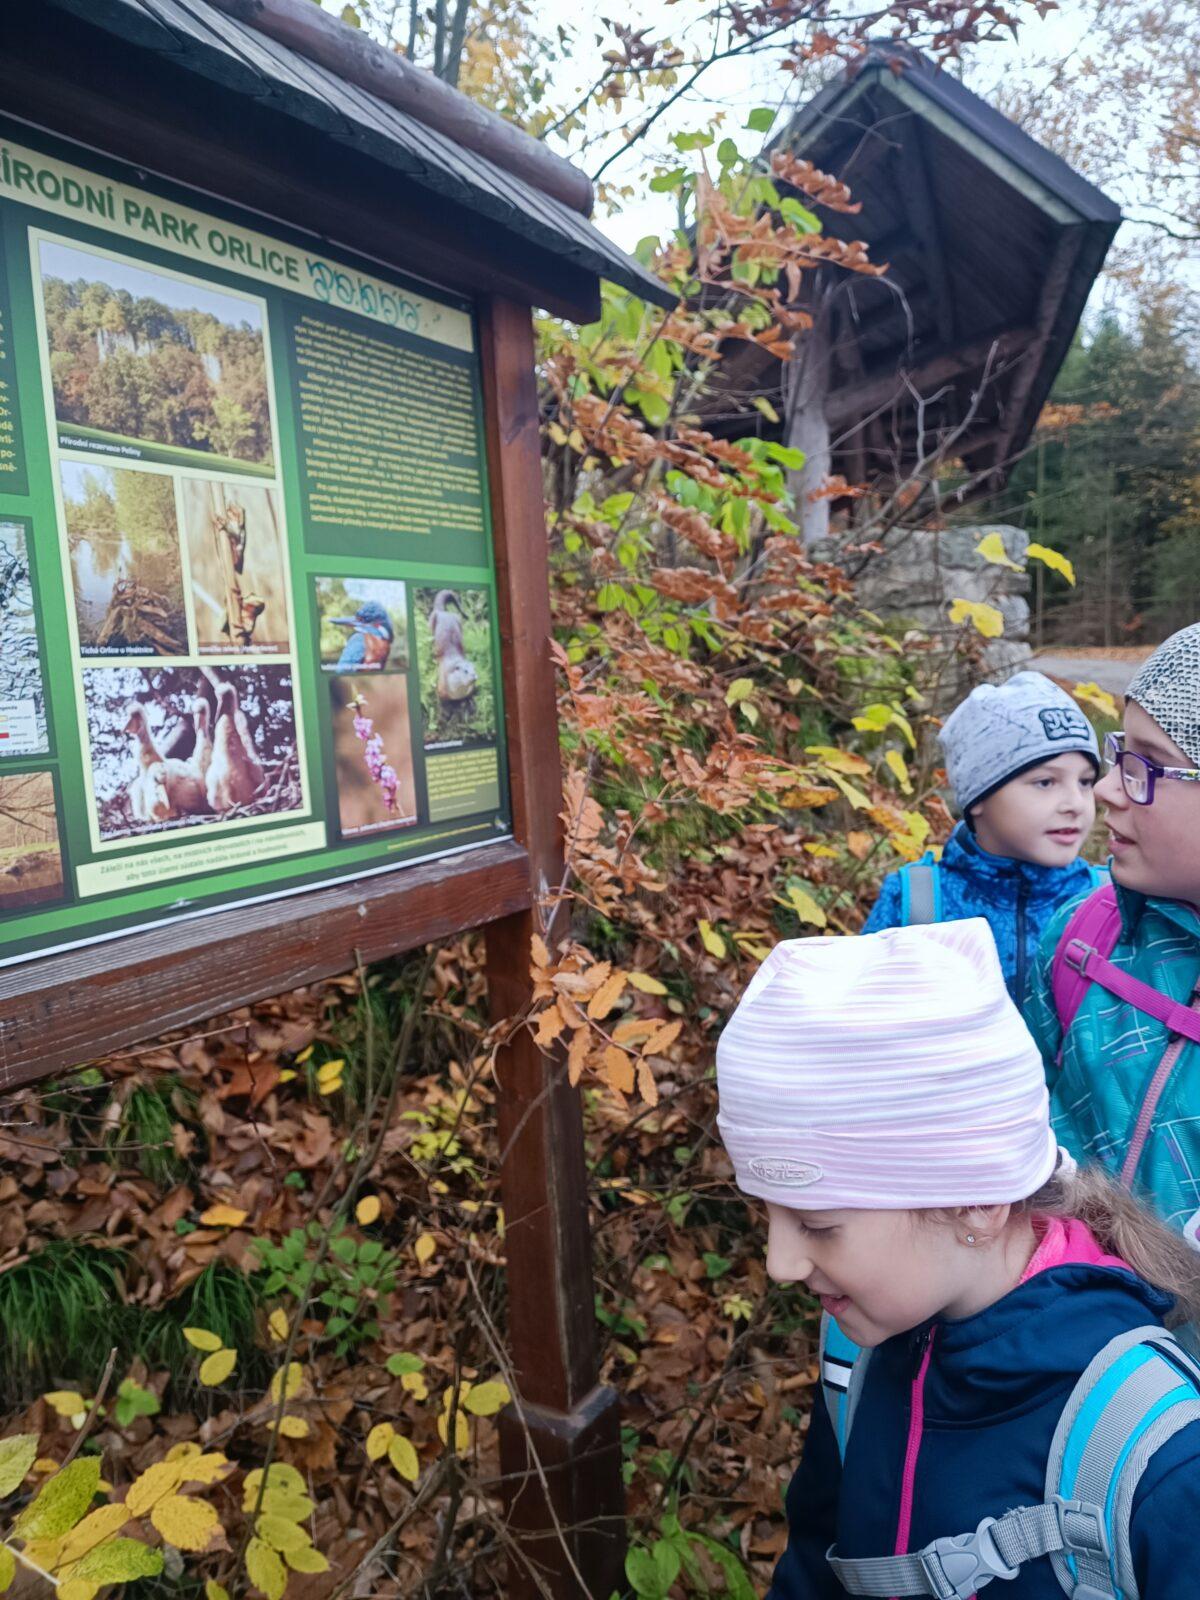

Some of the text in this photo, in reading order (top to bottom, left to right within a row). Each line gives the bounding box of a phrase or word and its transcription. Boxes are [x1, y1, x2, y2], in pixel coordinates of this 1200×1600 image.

[0, 147, 300, 282] ÍRODNÍ PARK ORLICE
